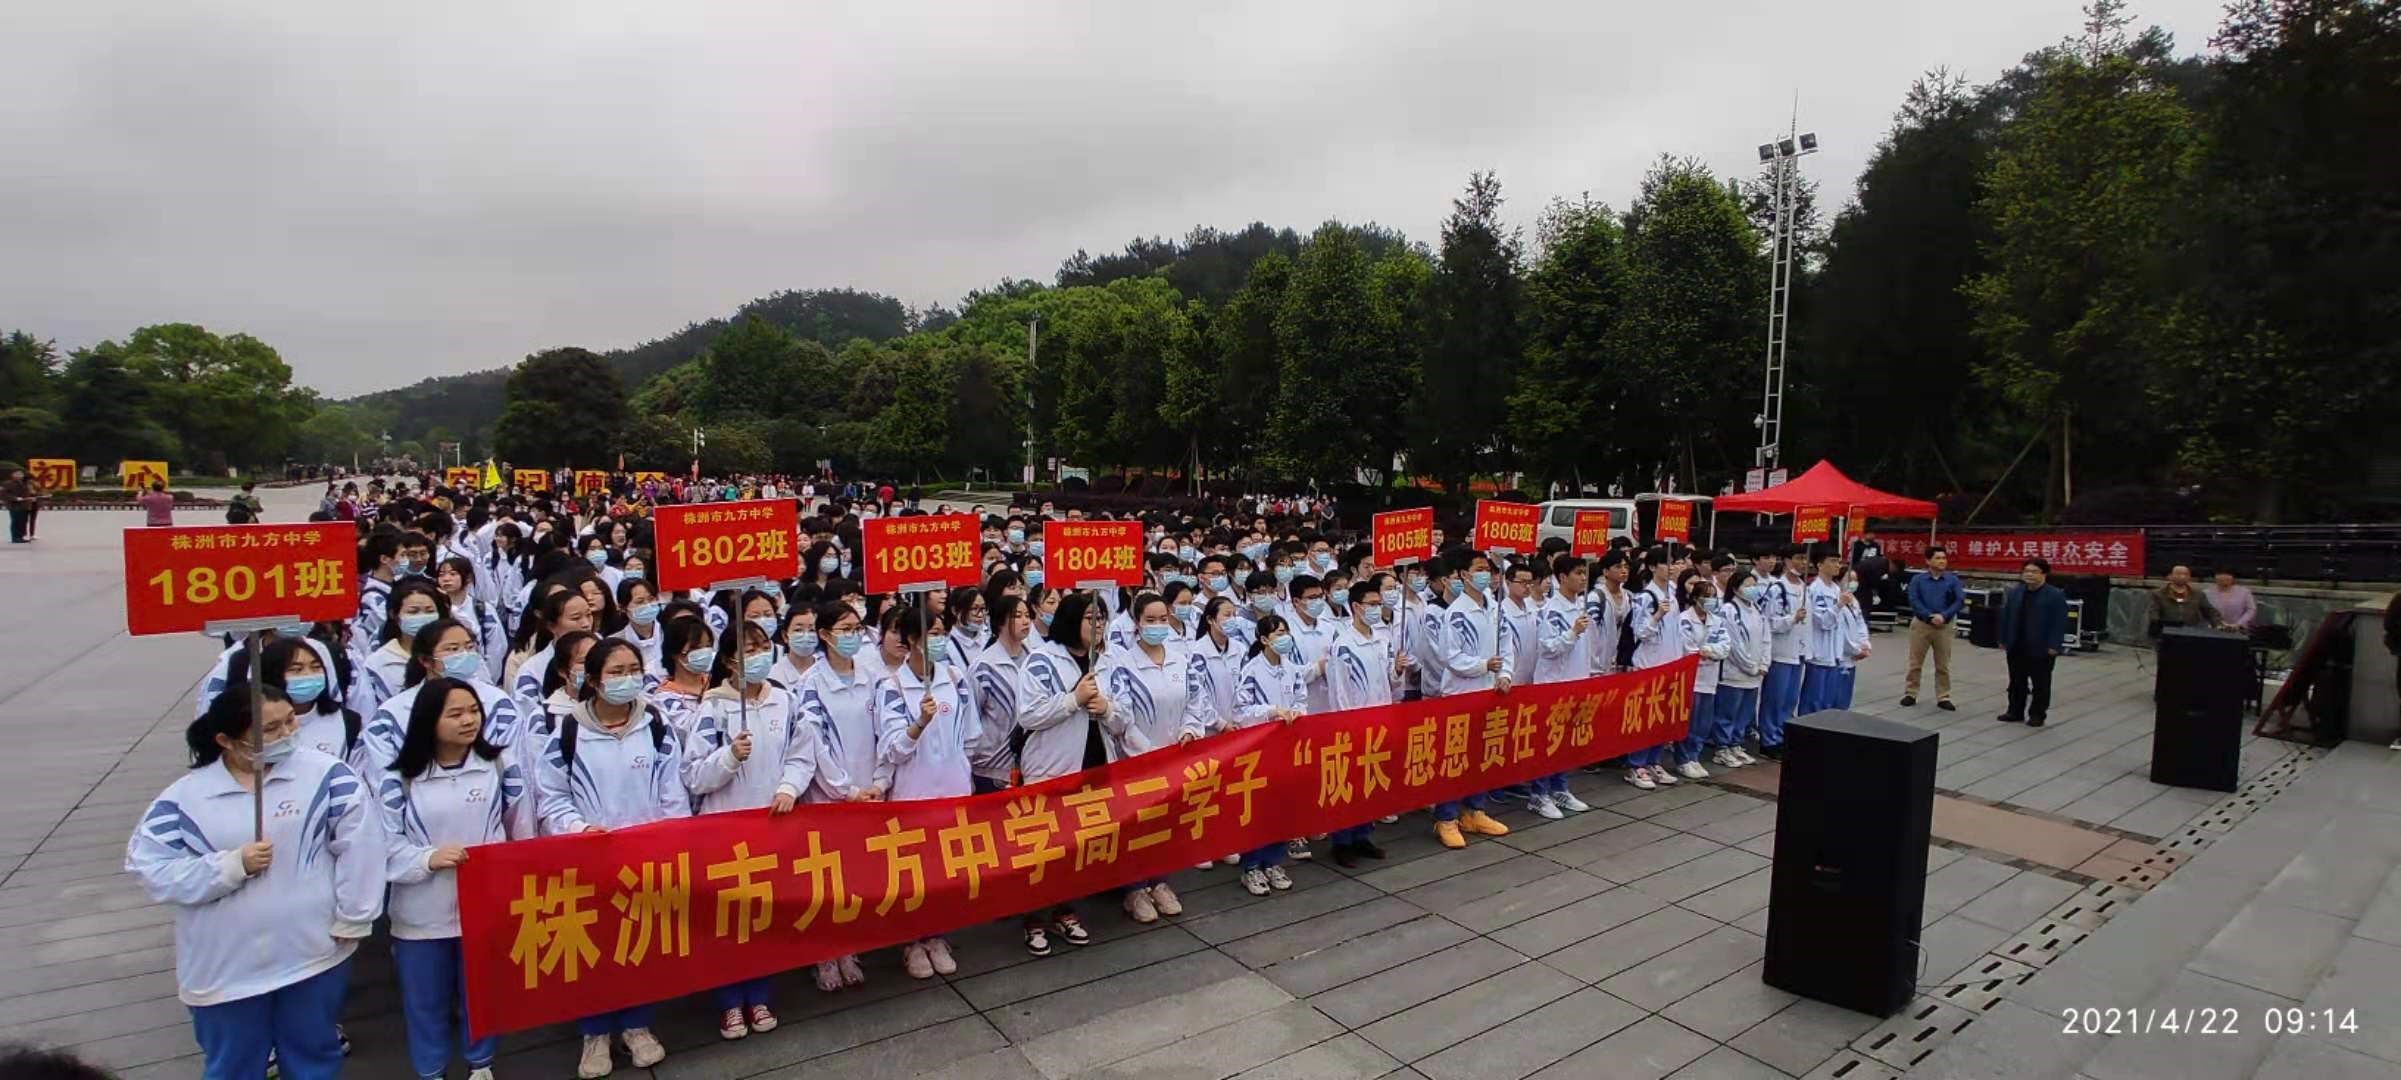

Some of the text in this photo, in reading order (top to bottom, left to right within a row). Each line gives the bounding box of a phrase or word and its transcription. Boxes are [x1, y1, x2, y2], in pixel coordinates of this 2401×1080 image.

[30, 460, 74, 490] 初
[127, 464, 166, 489] 心
[516, 471, 543, 491] 记
[577, 470, 605, 494] 使
[683, 507, 774, 525] 株洲市九方中学
[885, 520, 961, 535] 株洲市九方中学
[170, 530, 322, 550] 株洲市九方中学
[1378, 528, 1429, 553] 1805班
[1481, 520, 1535, 542] 1806班
[671, 529, 790, 568] 1802班
[875, 540, 974, 574] 1803班
[1053, 545, 1137, 571] 1804班
[1967, 539, 2129, 560] 维护人民群众安全
[150, 558, 345, 606] 1801班
[510, 751, 1268, 989] 株洲市九方中学高三学子
[1403, 713, 1471, 787] 感恩
[1479, 703, 1538, 772] 责任
[1620, 671, 1690, 735] 成长礼
